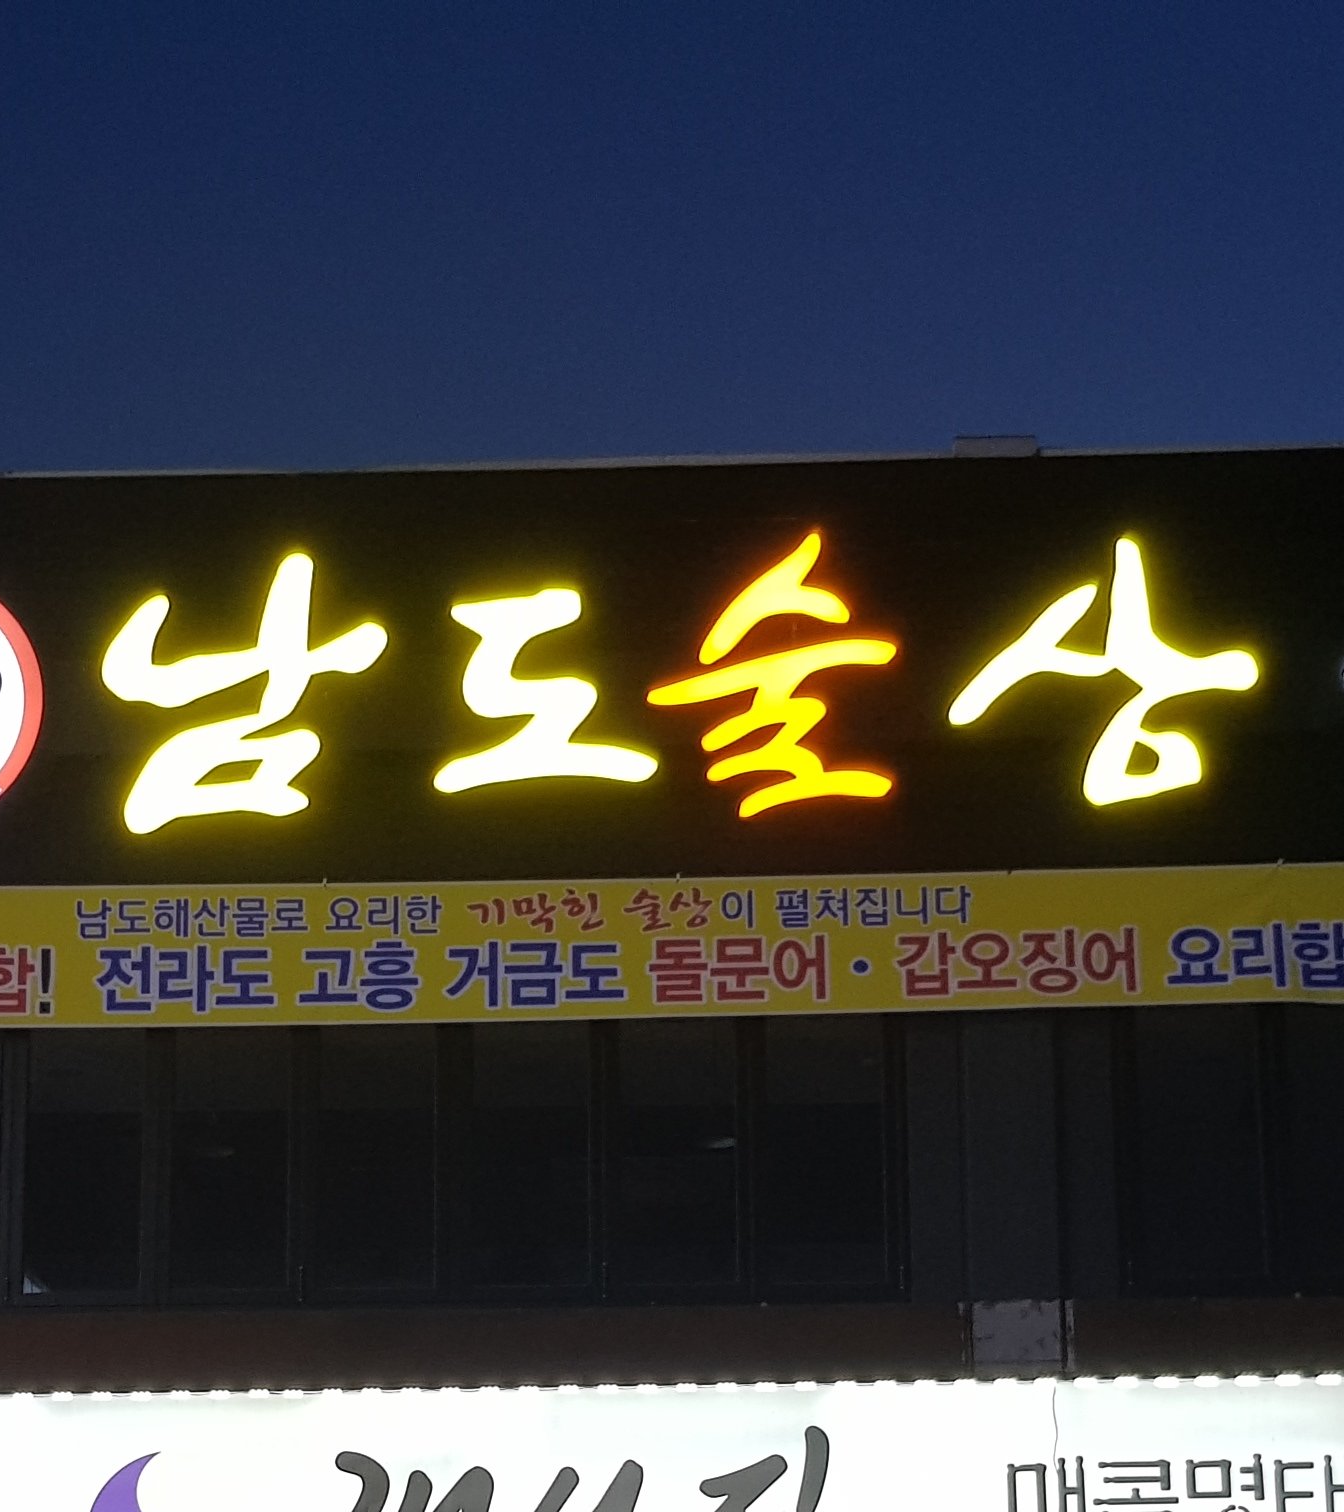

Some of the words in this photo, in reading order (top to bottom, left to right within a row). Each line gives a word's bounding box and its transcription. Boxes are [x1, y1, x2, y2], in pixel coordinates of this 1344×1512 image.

[99, 531, 1259, 834] 남도술상
[75, 897, 310, 938] 남도해산물로
[323, 894, 442, 935] 요리한
[466, 892, 605, 933] 기막힌
[622, 886, 754, 932] 술상이
[774, 884, 971, 928] 펼쳐집니다
[95, 942, 278, 1012] 전라도
[294, 940, 421, 1010] 고흥
[444, 938, 625, 1007] 거금도
[648, 936, 830, 1003] 돌문어
[896, 927, 1141, 996] 갑오징어
